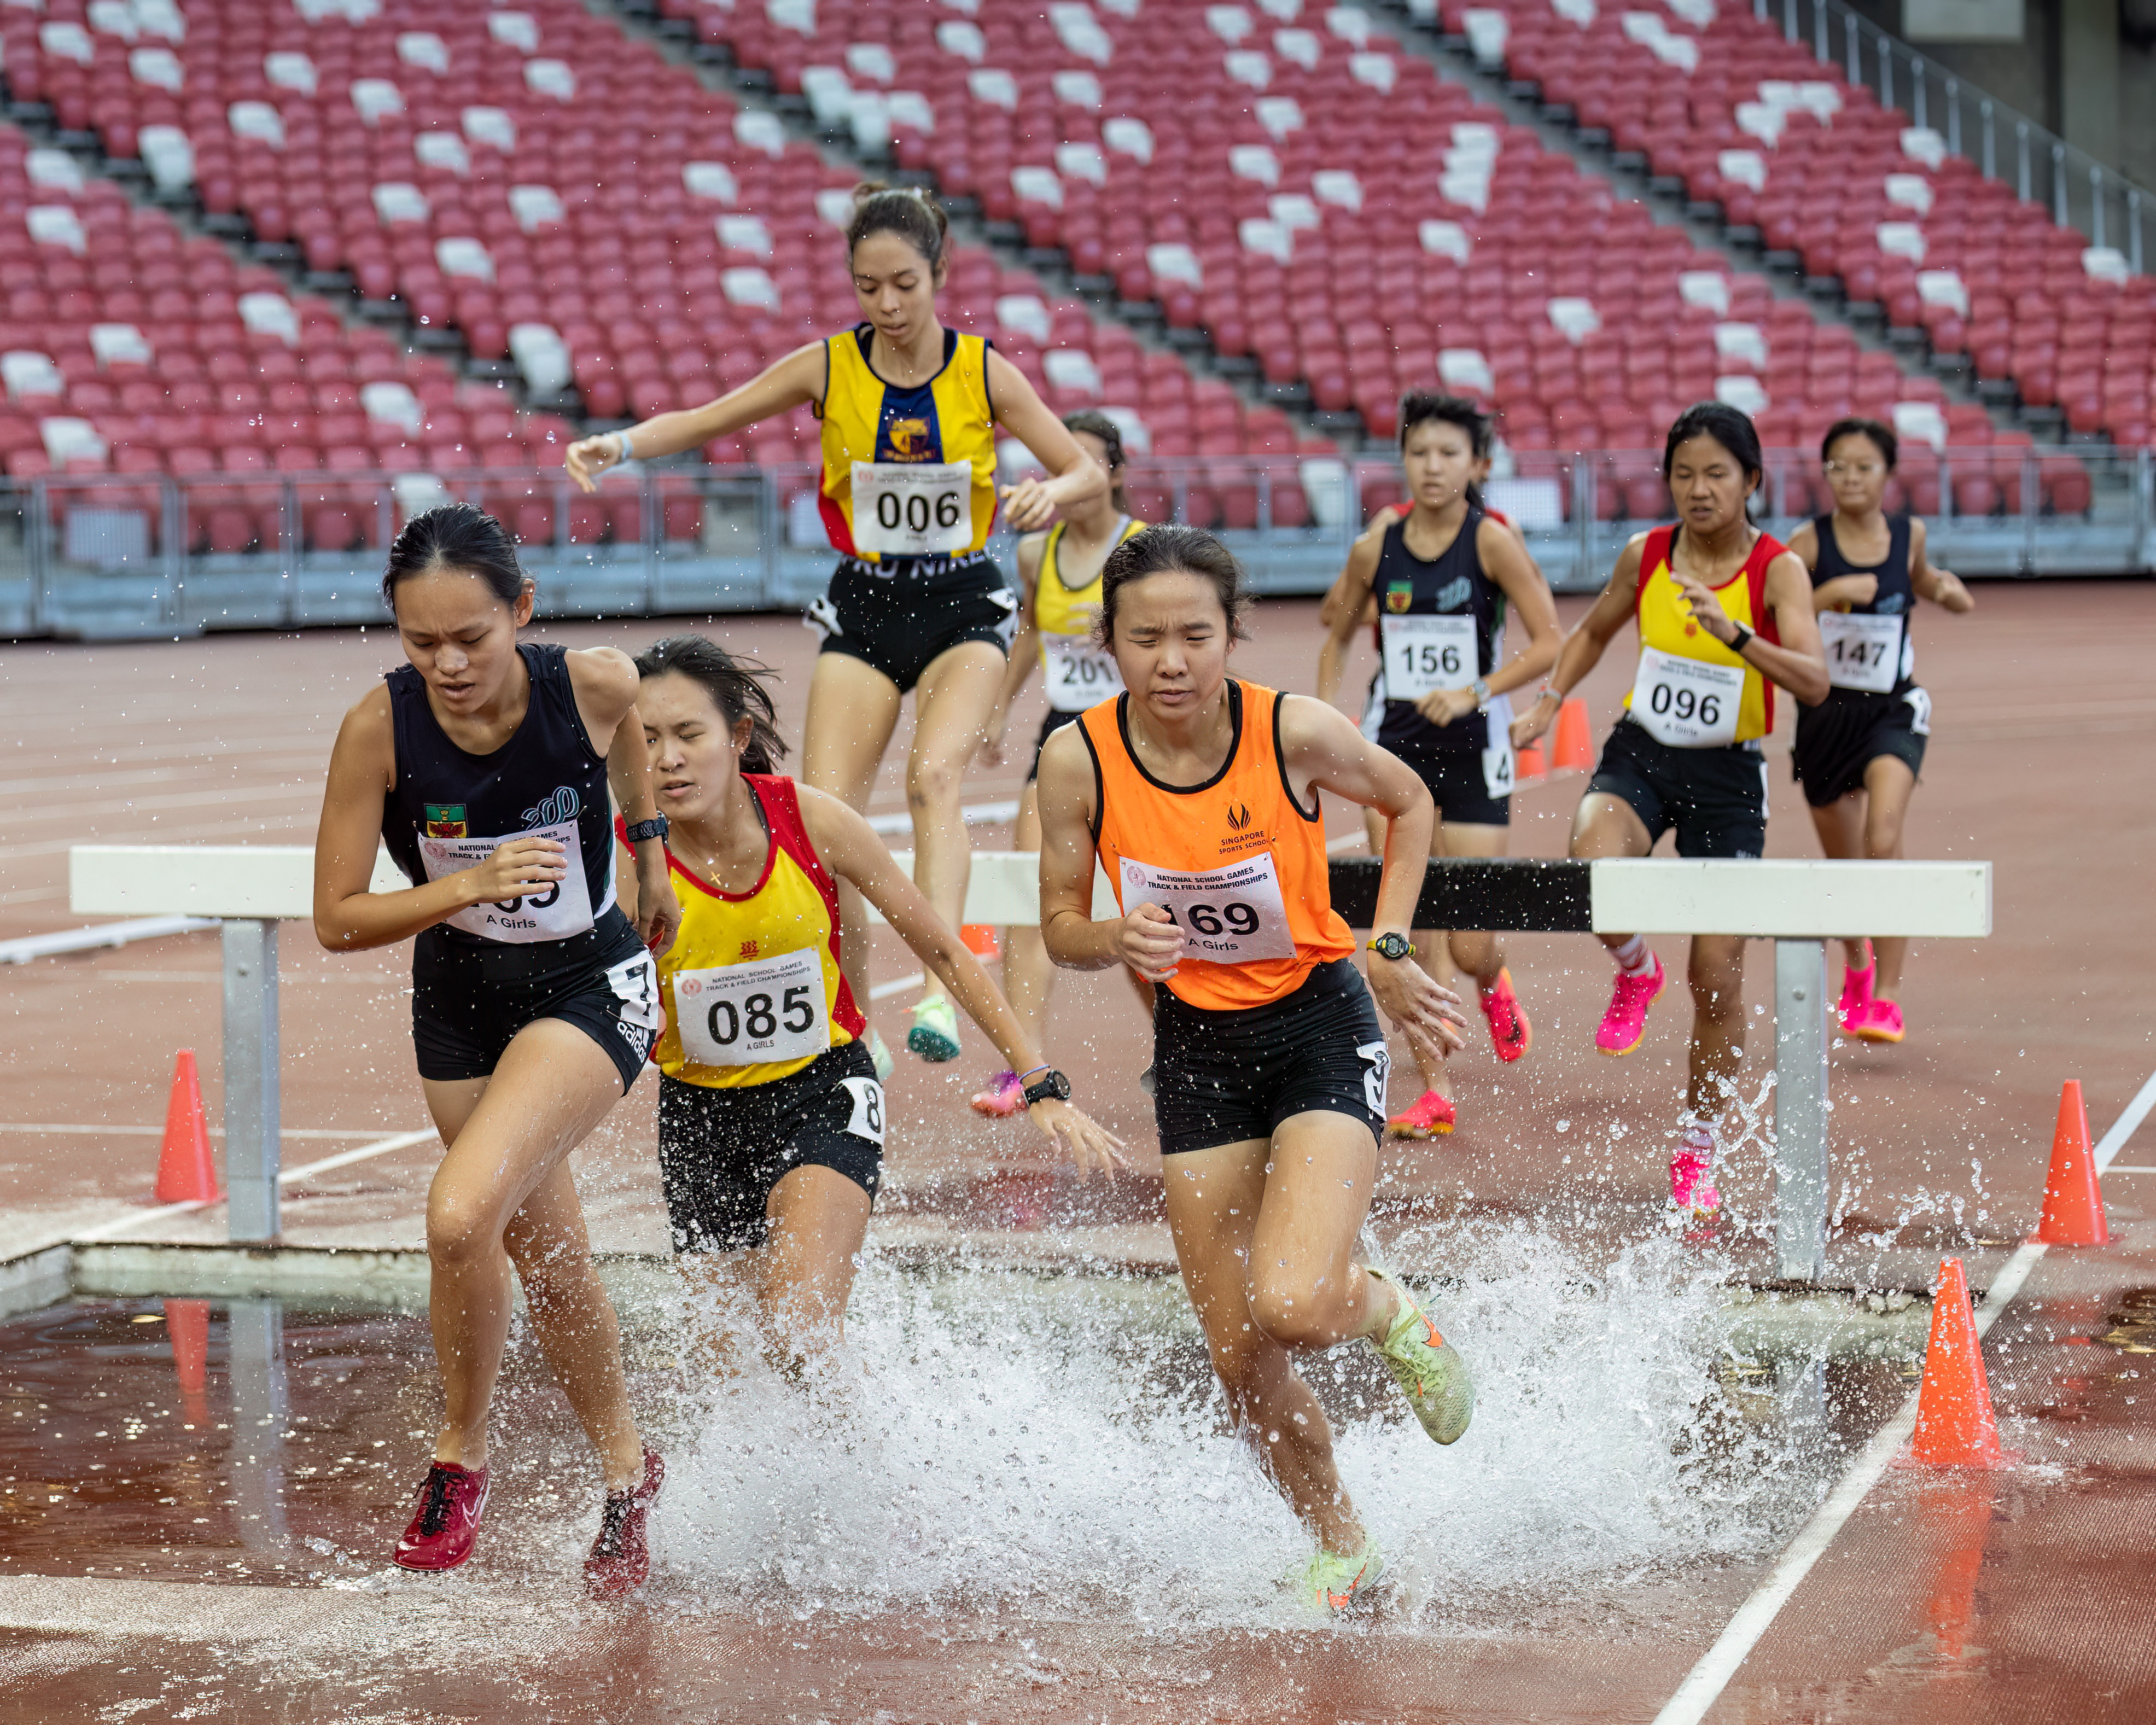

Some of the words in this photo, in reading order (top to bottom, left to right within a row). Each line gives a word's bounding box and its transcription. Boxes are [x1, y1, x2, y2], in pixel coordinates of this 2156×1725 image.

[878, 491, 959, 533] 006
[1402, 645, 1460, 674] 156
[1833, 639, 1886, 667] 147
[1651, 683, 1721, 725] 096
[1219, 845, 1243, 854] SPORTS
[1221, 830, 1265, 846] SINGAPORE
[1147, 881, 1172, 890] TRACK
[1204, 872, 1268, 890] CHAMPIONSHIPS
[1157, 874, 1193, 883] NATIONAL
[1194, 875, 1226, 883] SCHOOL
[1227, 866, 1254, 880] GAMES
[486, 914, 497, 925] A
[500, 917, 537, 929] Girls
[1188, 938, 1200, 947] A
[1203, 940, 1239, 951] Girls
[706, 983, 729, 992] TRACK
[737, 978, 755, 987] FIELD
[757, 966, 811, 983] CHAMPIONSHIPS
[712, 974, 745, 983] NATIONAL
[749, 968, 776, 977] SCHOOL
[779, 961, 803, 971] GAMES
[625, 961, 651, 1017] 7
[708, 985, 814, 1045] 085
[617, 1022, 647, 1063] adidas
[753, 1040, 774, 1050] GIRLS
[864, 1082, 881, 1134] 8
